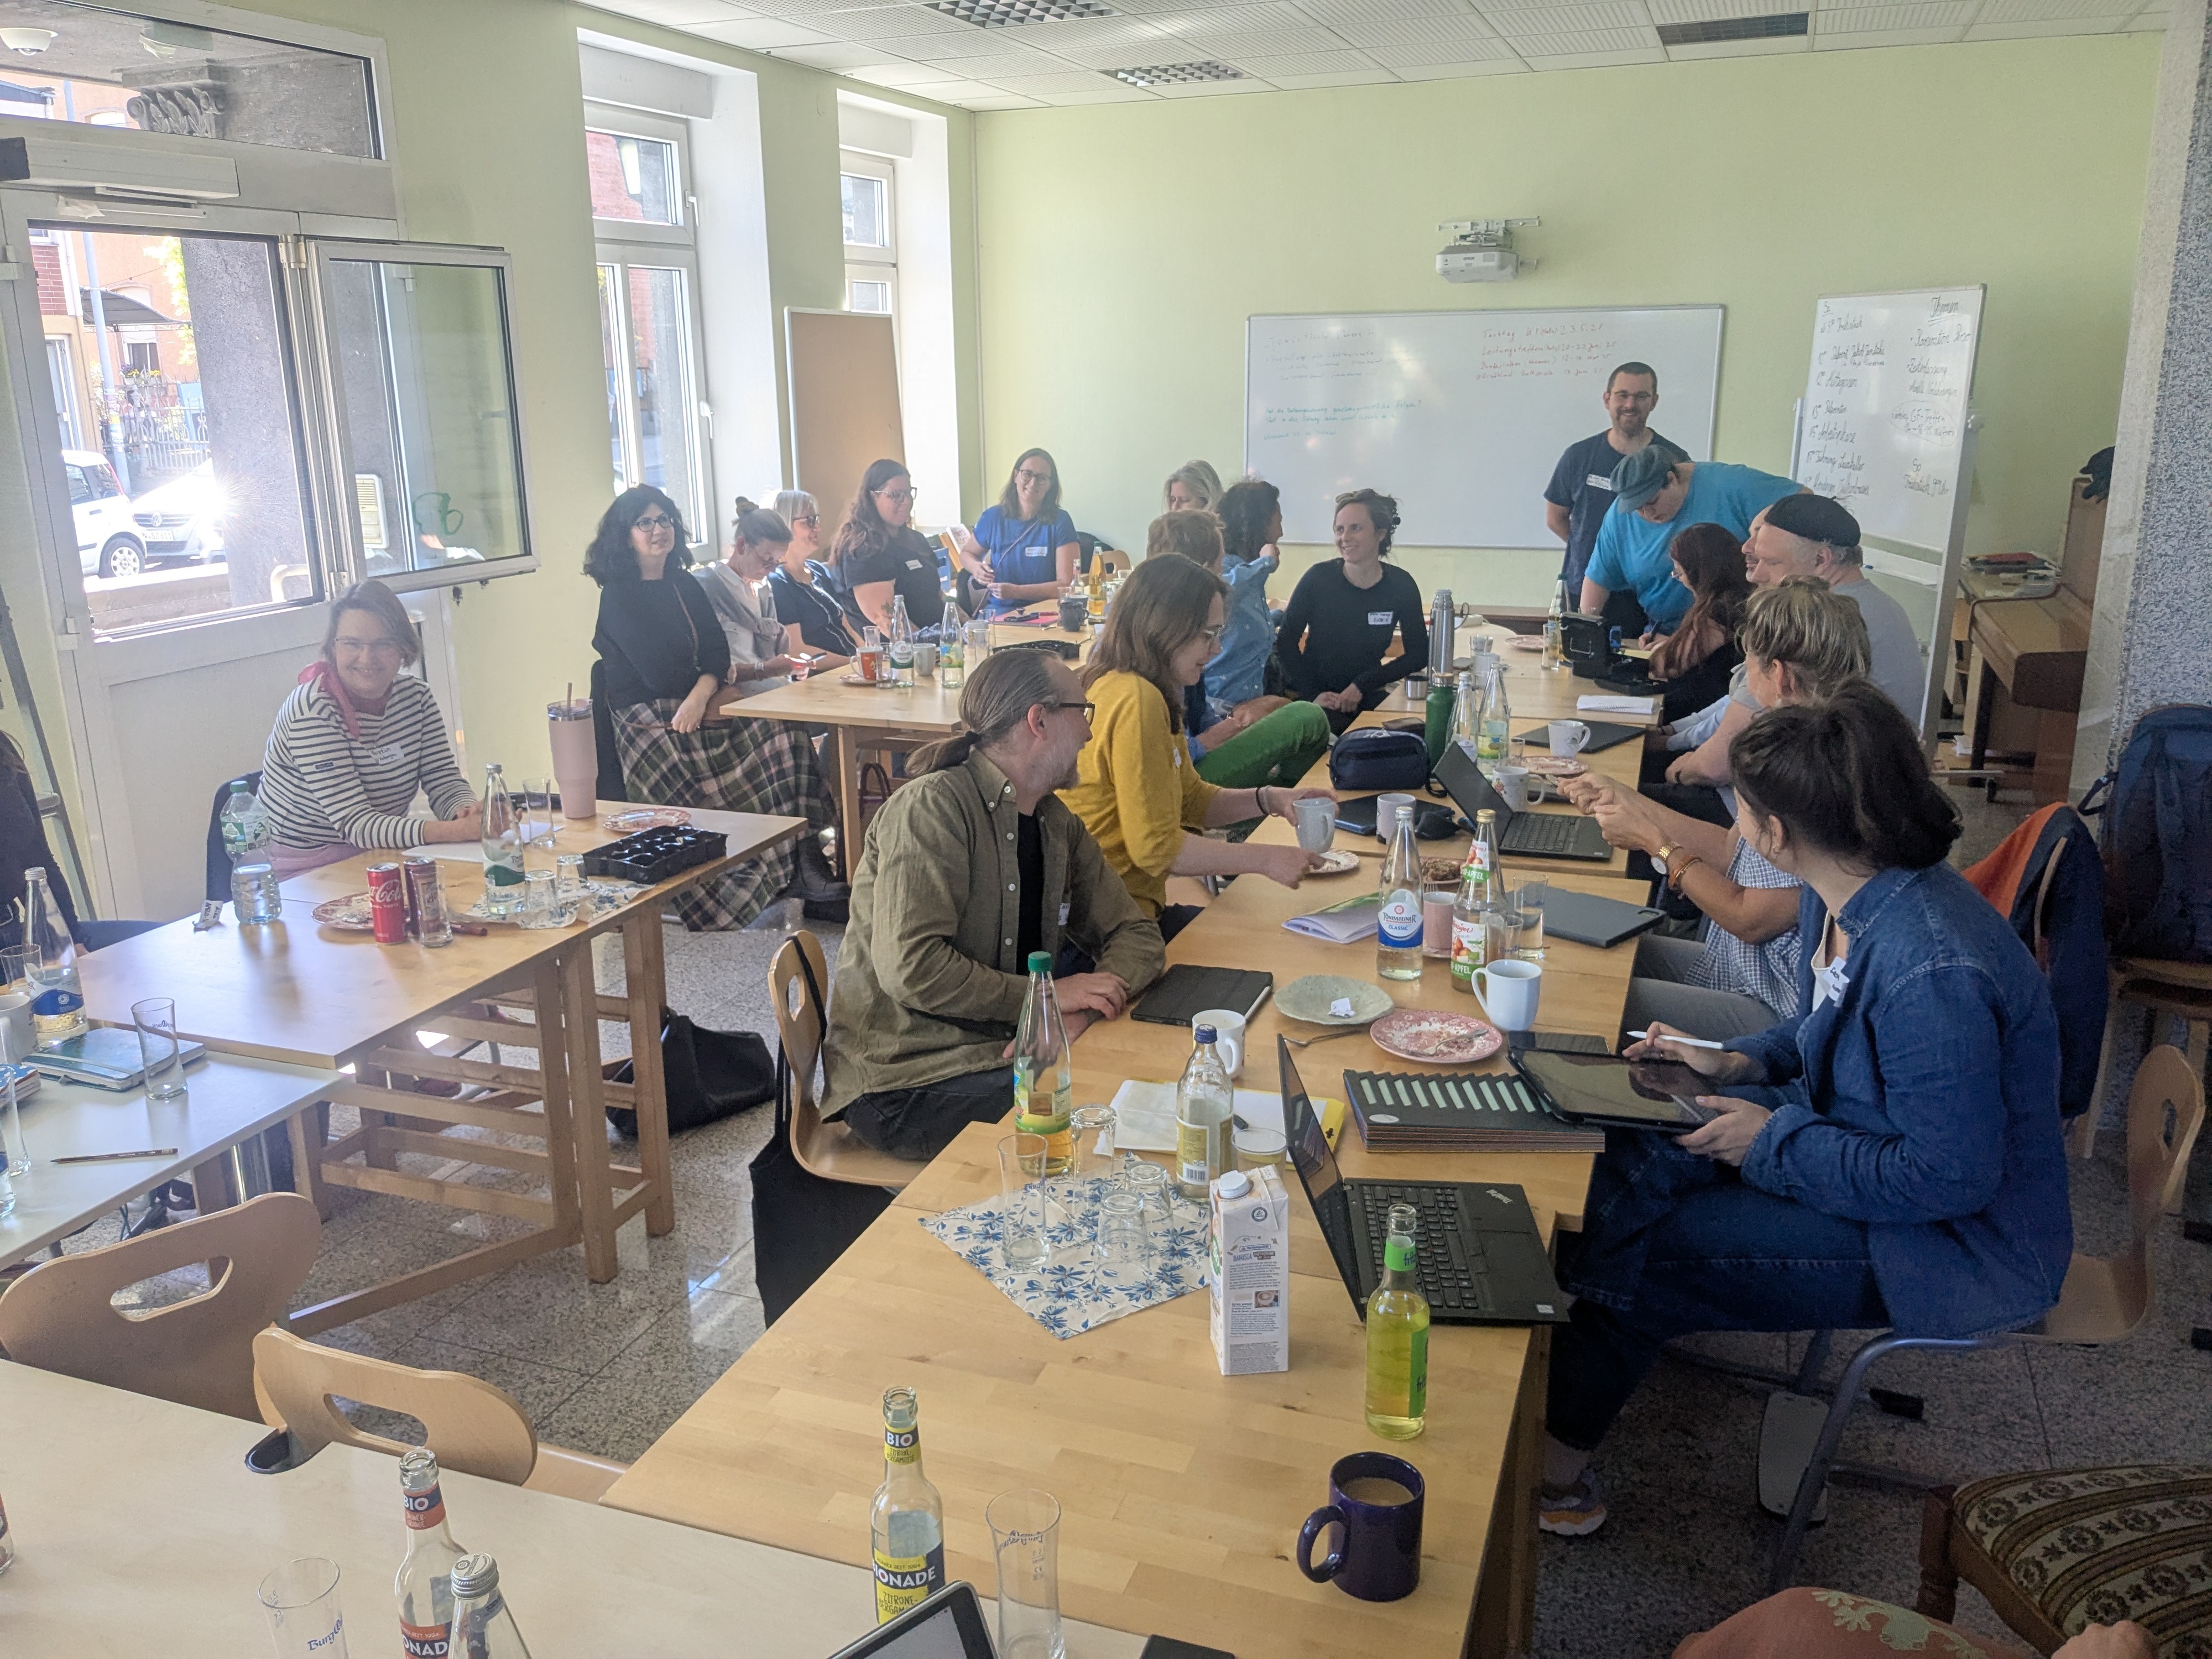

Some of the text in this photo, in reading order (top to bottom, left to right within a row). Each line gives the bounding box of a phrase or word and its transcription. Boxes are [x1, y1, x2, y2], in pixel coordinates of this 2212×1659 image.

[1233, 1253, 1253, 1261] BARISTA
[887, 1431, 913, 1447] BIO
[404, 1494, 429, 1511] BIO
[873, 1565, 937, 1587] IONADE
[883, 1590, 919, 1606] ZITRONE-
[879, 1598, 905, 1615] BERGAM
